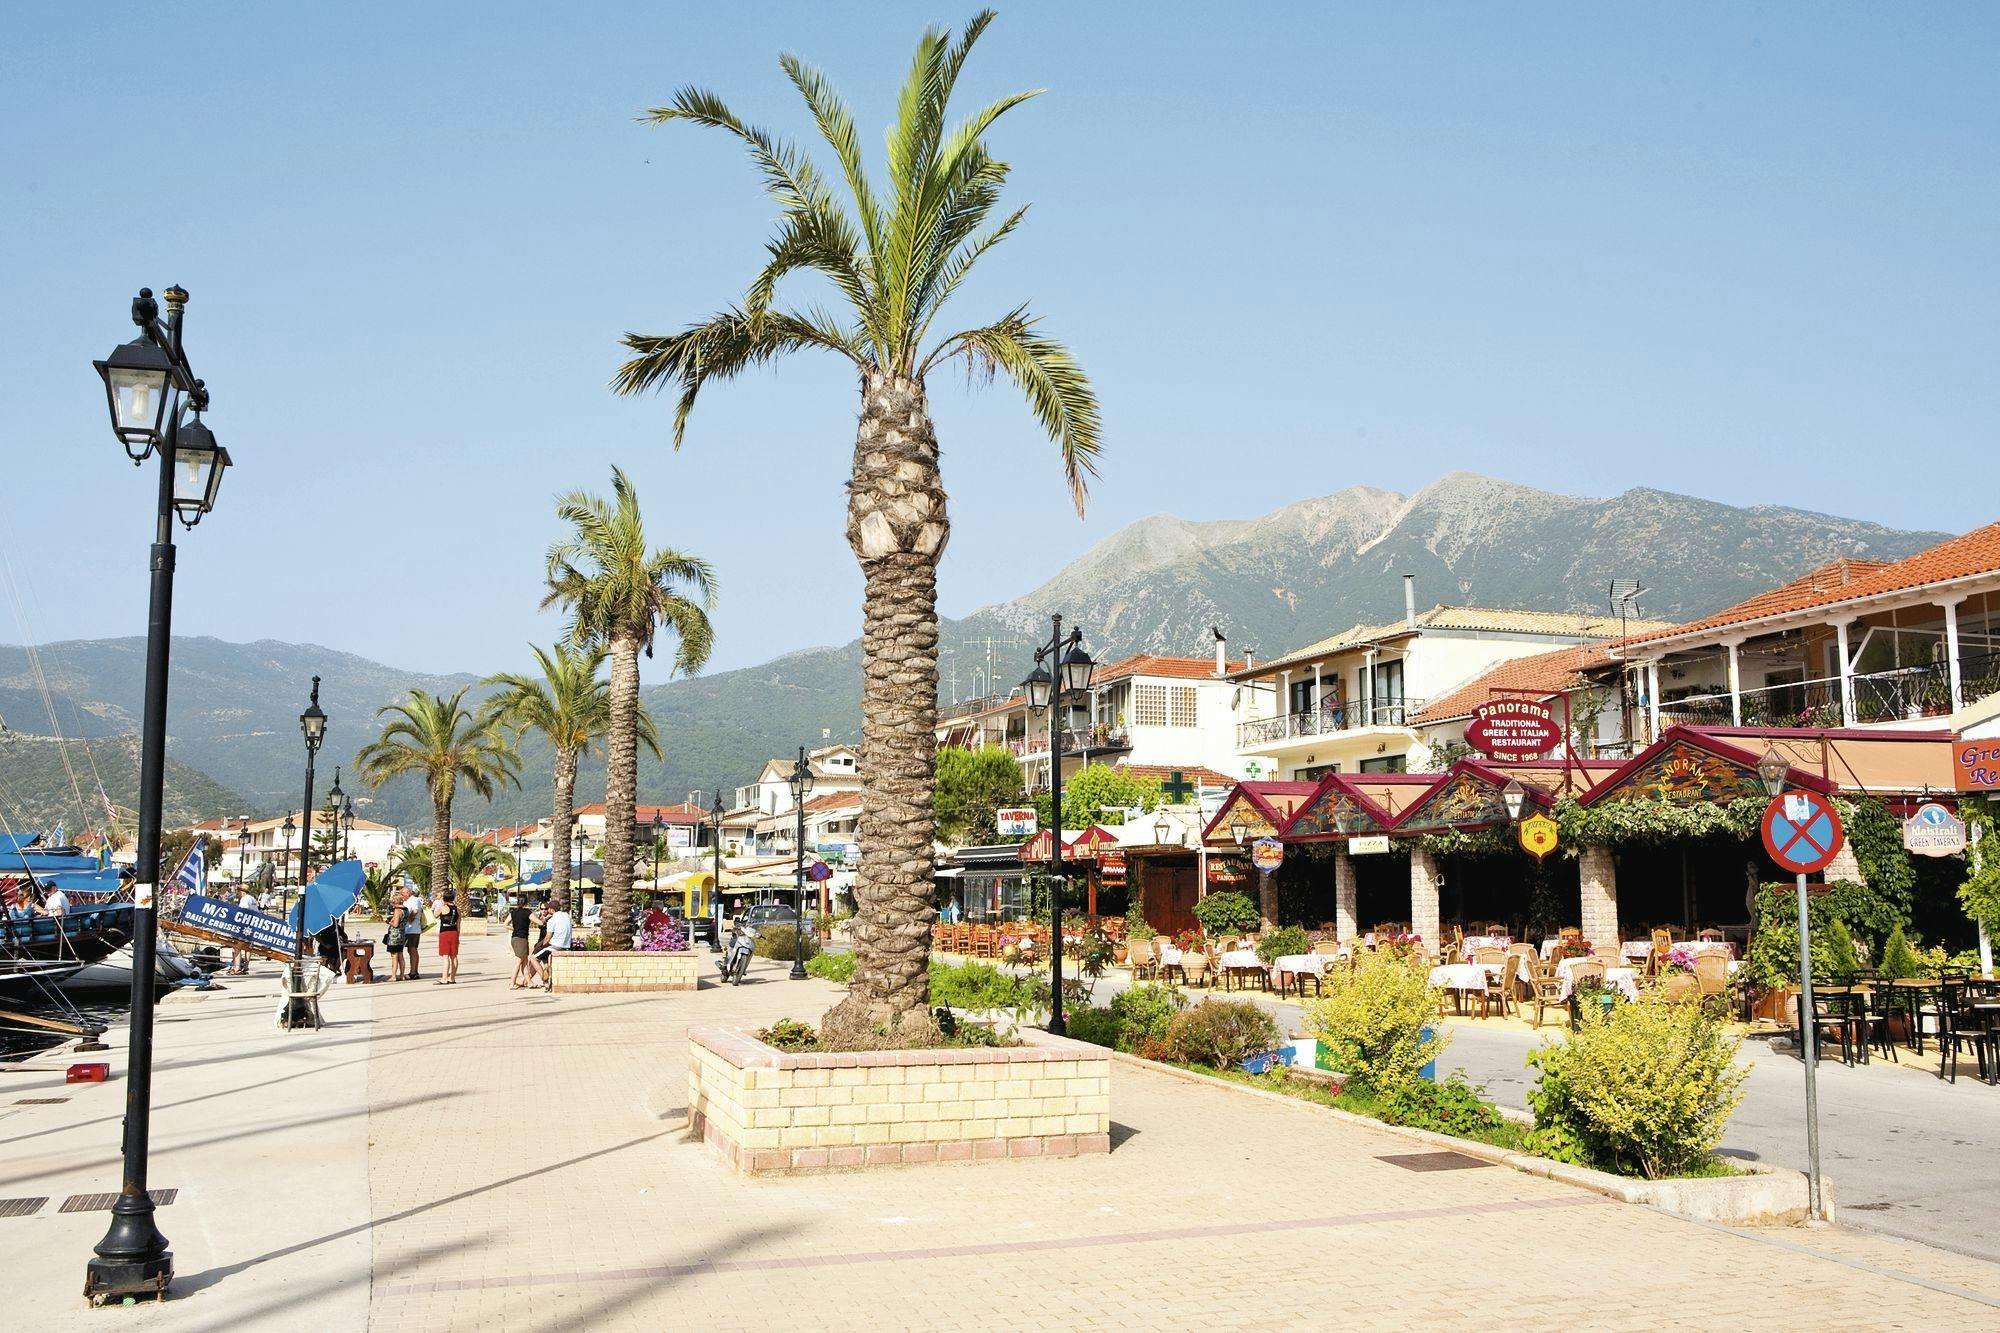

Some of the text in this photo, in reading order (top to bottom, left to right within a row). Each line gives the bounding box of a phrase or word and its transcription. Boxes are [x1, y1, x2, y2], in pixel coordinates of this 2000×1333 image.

[1490, 719, 1541, 728] TRADITIONAL
[1482, 729, 1549, 738] GREEK & ITALIAN
[1491, 738, 1542, 747] RESTAURANT
[1493, 751, 1518, 762] SINCE
[1969, 771, 2000, 787] Re
[1000, 811, 1035, 821] TAVERNA
[1210, 858, 1253, 872] RESTAURANT
[1216, 873, 1247, 881] PANORAMA
[201, 902, 297, 940] M/S CHRISTINA
[185, 911, 208, 926] DAILY
[208, 918, 242, 934] CRUISES
[253, 931, 287, 948] CHARTER
